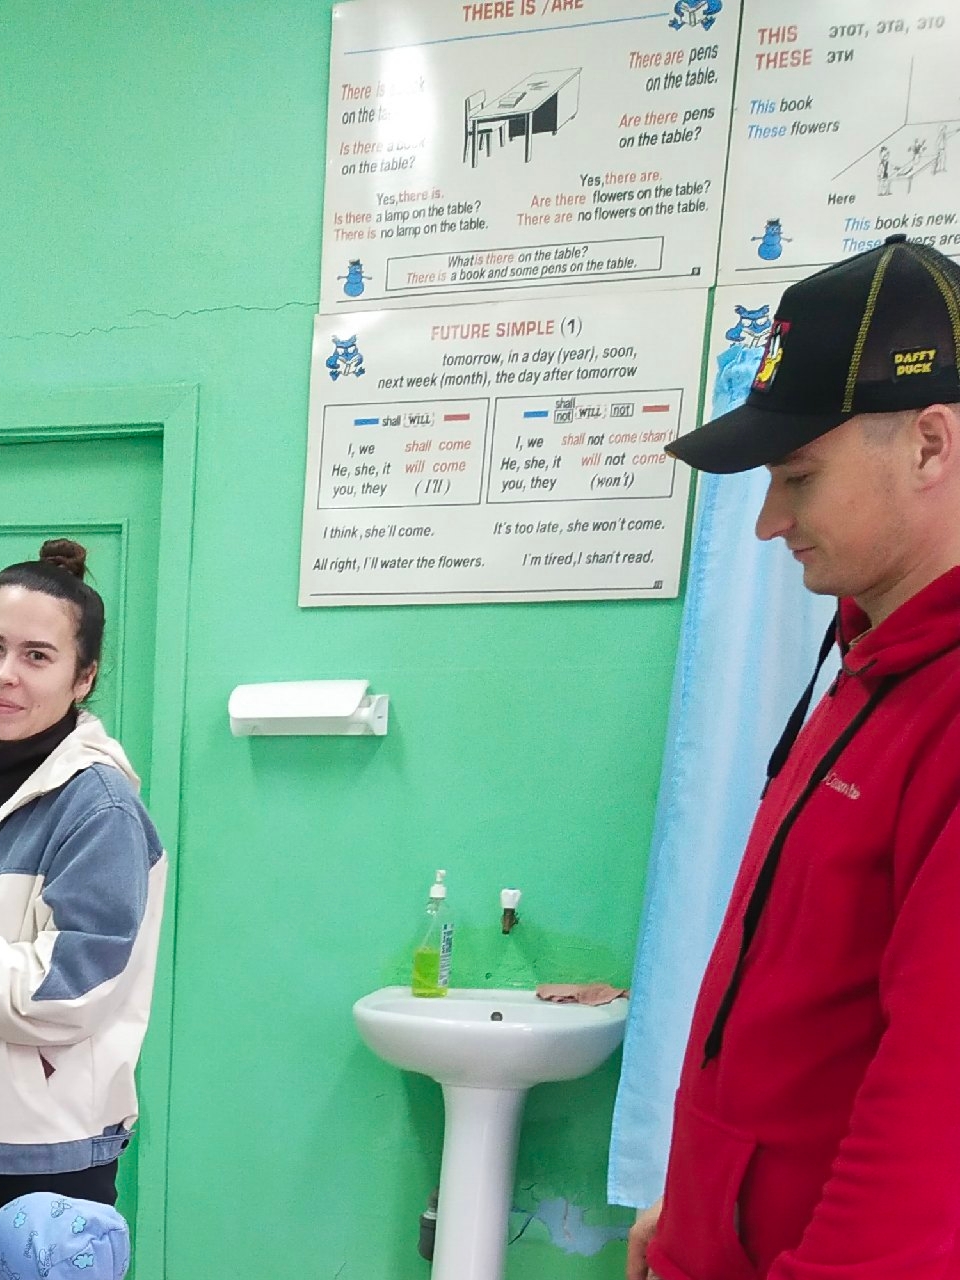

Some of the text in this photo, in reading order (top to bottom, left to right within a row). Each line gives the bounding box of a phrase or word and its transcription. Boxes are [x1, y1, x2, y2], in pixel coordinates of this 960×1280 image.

[463, 0, 514, 22] THERE
[520, 0, 536, 16] IS
[757, 25, 798, 45] THIS
[828, 16, 946, 39] этот, эта, это
[629, 44, 719, 69] There are pens
[756, 49, 812, 70] THESE
[826, 49, 854, 64] эти
[645, 66, 718, 92] on the table.
[341, 83, 372, 101] There
[341, 110, 356, 125] on
[358, 105, 375, 123] the
[749, 95, 813, 115] This book
[618, 107, 715, 129] Are there pens
[619, 125, 702, 149] on the table?
[747, 119, 840, 139] These flowers
[353, 140, 383, 155] there
[341, 155, 416, 176] on the table?
[530, 179, 711, 209] Are there flowers on the table?
[827, 193, 856, 206] Here
[345, 204, 445, 224] there lamp on the
[517, 199, 709, 227] There are no flowers on the table.
[844, 212, 958, 232] This book is new.
[334, 217, 489, 241] There no lamp on the table.
[486, 245, 589, 266] there the table?
[842, 238, 881, 253] These
[406, 256, 638, 285] There book and some pens the table.
[430, 316, 583, 341] FUTURE SIMPLE (1)
[442, 345, 638, 368] tomorrow, day (year), soon,
[894, 349, 937, 364] DAFFY
[377, 364, 638, 389] next week (month), the day after tomorrow
[896, 362, 933, 376] DUCK
[555, 397, 576, 409] shall
[578, 406, 602, 418] WILL
[382, 414, 431, 427] shall WILL
[359, 439, 472, 455] we shall come
[527, 437, 544, 448] we
[561, 432, 586, 446] shall
[587, 433, 605, 446] not
[608, 432, 637, 444] come
[331, 460, 466, 478] He, she, will come
[500, 453, 667, 472] He, she, will not come
[332, 481, 388, 499] you, they
[501, 471, 635, 493] you, they (won't)
[398, 525, 435, 537] come.
[493, 517, 665, 535] It's too late, she won't come.
[312, 555, 485, 573] All right, I'll water the flowers.
[522, 549, 654, 566] I'm shan't read.
